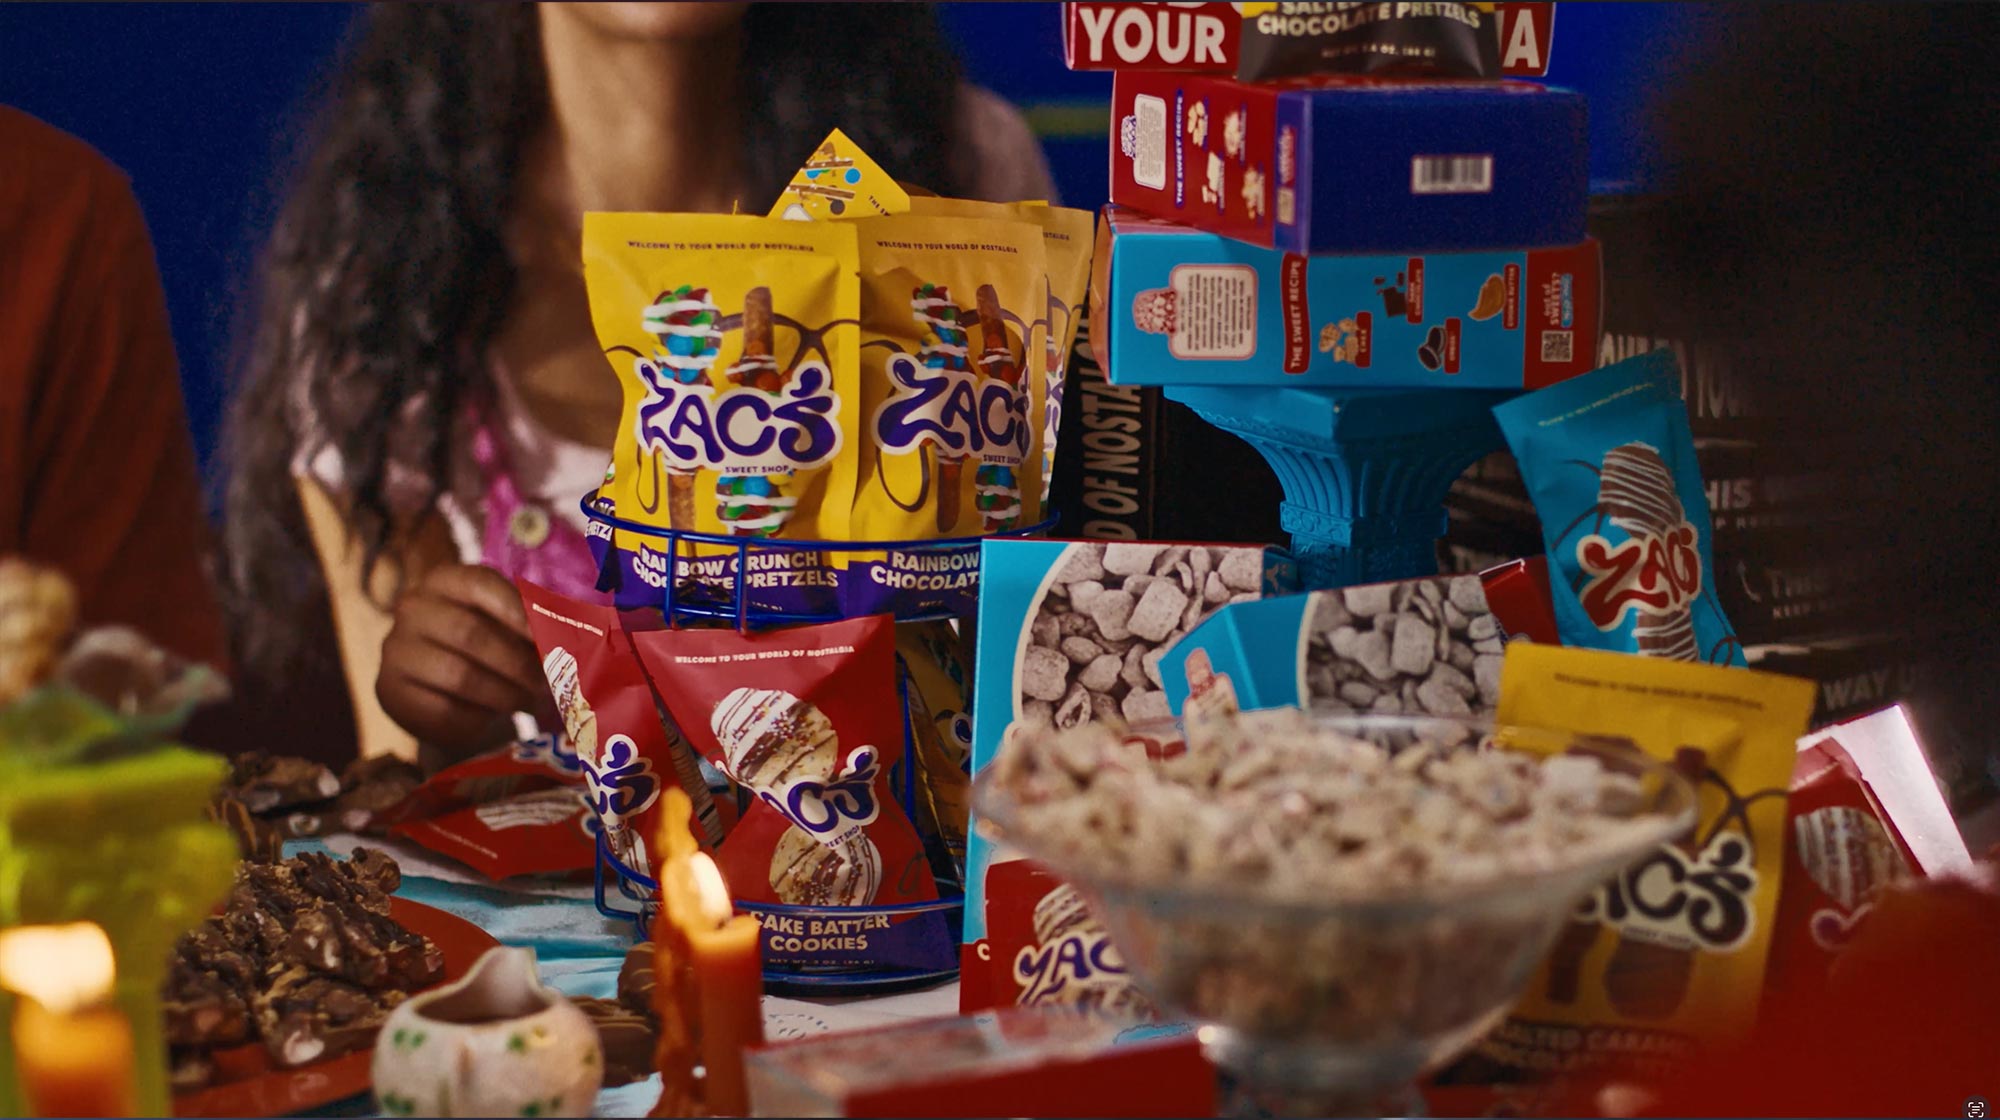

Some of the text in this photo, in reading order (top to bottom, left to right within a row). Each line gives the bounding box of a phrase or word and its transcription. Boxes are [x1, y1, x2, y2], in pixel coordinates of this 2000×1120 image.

[1257, 3, 1481, 36] CHOCOLATE PRETZELS
[1079, 7, 1227, 63] YOUR
[1175, 96, 1183, 137] RECIPE
[1175, 139, 1183, 178] SWEET
[627, 240, 670, 249] WELCOME
[716, 242, 746, 250] WORLD
[750, 242, 761, 250] OF
[764, 242, 814, 252] NOSTALGIA
[876, 240, 1018, 254] WELCOME TO YOUR WORLD OF NOSTALGIA
[1289, 261, 1304, 369] THE SWEET RECIPE
[725, 465, 789, 474] SWEET SHOP
[983, 454, 1006, 464] SWEET
[1081, 476, 1140, 515] OF
[641, 548, 725, 577] RAIBOW
[892, 551, 980, 572] RAINBOW
[870, 565, 980, 590] CHOCOLAT
[674, 645, 856, 664] WELCOME TO YOUR WORLD OF NOSTALGIA
[750, 911, 891, 936] CAKE BATTER
[769, 934, 868, 953] COOKIES
